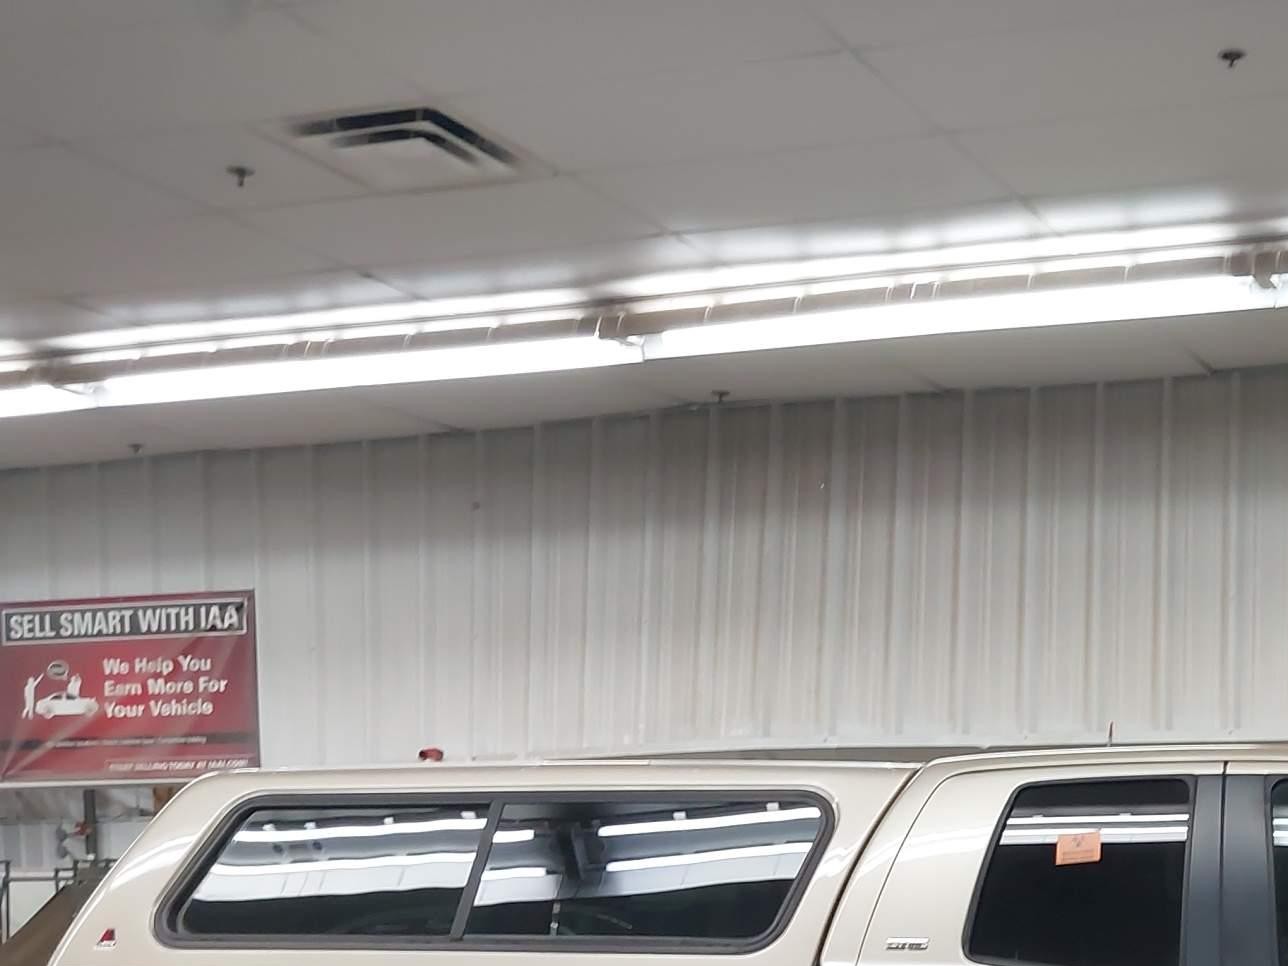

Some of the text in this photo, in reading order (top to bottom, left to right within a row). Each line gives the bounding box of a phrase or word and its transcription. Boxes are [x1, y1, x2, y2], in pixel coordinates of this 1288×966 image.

[9, 603, 240, 640] SELL SMART WITH IAA
[103, 654, 212, 676] We Help You
[104, 676, 228, 697] Earn More For
[104, 698, 214, 718] Your Vehicle
